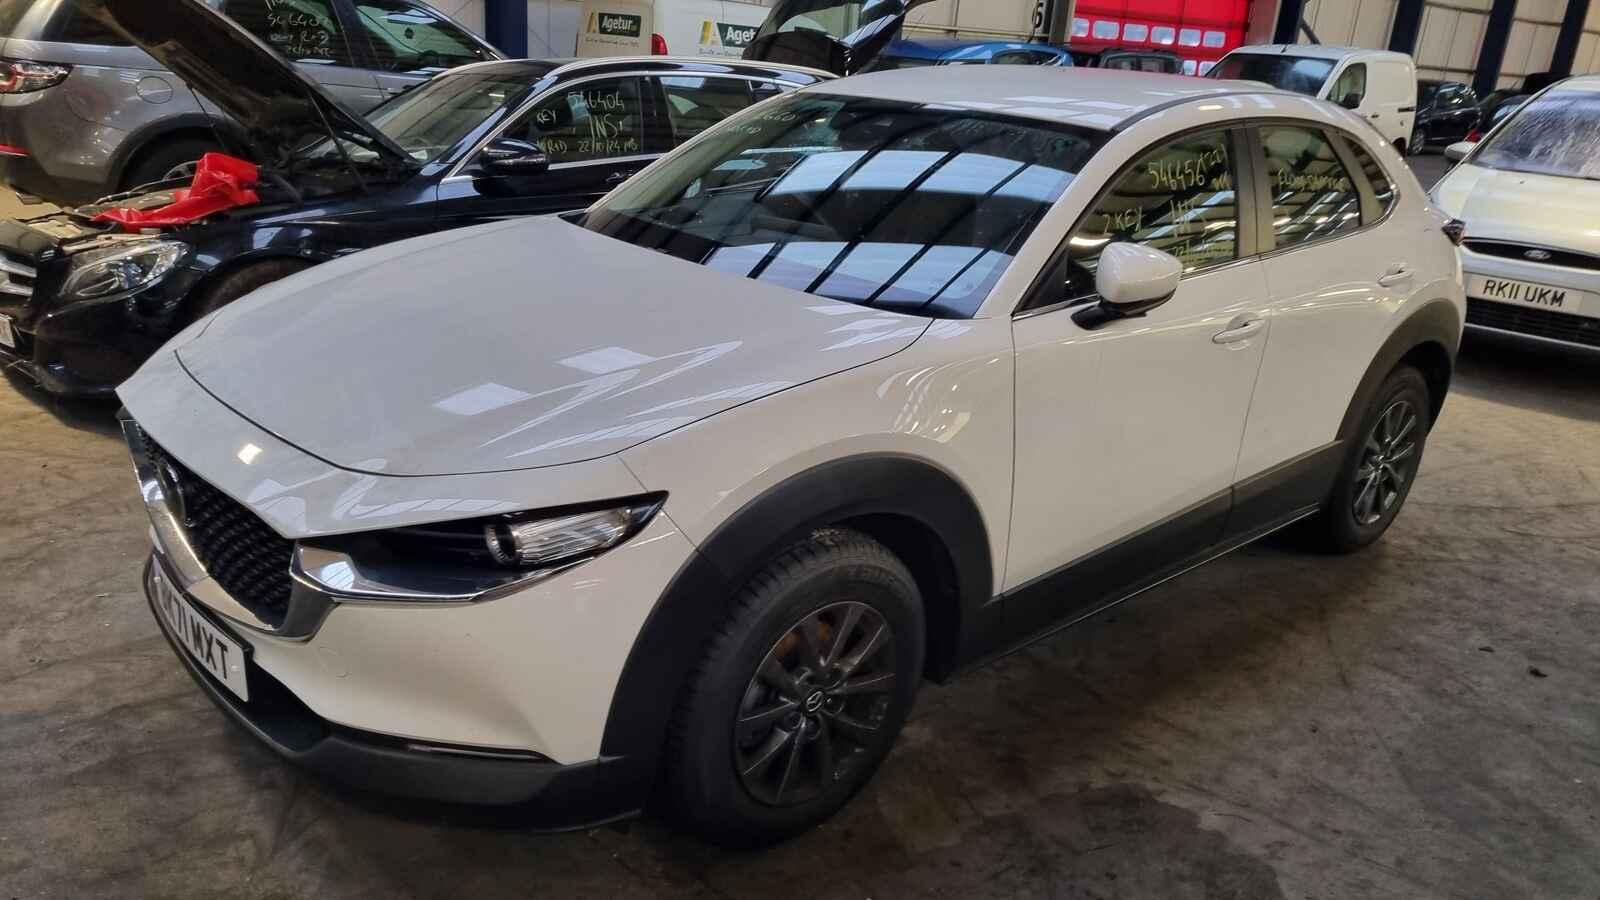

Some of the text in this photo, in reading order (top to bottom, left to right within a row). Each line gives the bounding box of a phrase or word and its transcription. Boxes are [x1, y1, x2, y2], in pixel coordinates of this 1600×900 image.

[601, 15, 633, 32] Agetur
[1482, 279, 1567, 308] RK11 UKM
[190, 615, 229, 680] MXT
